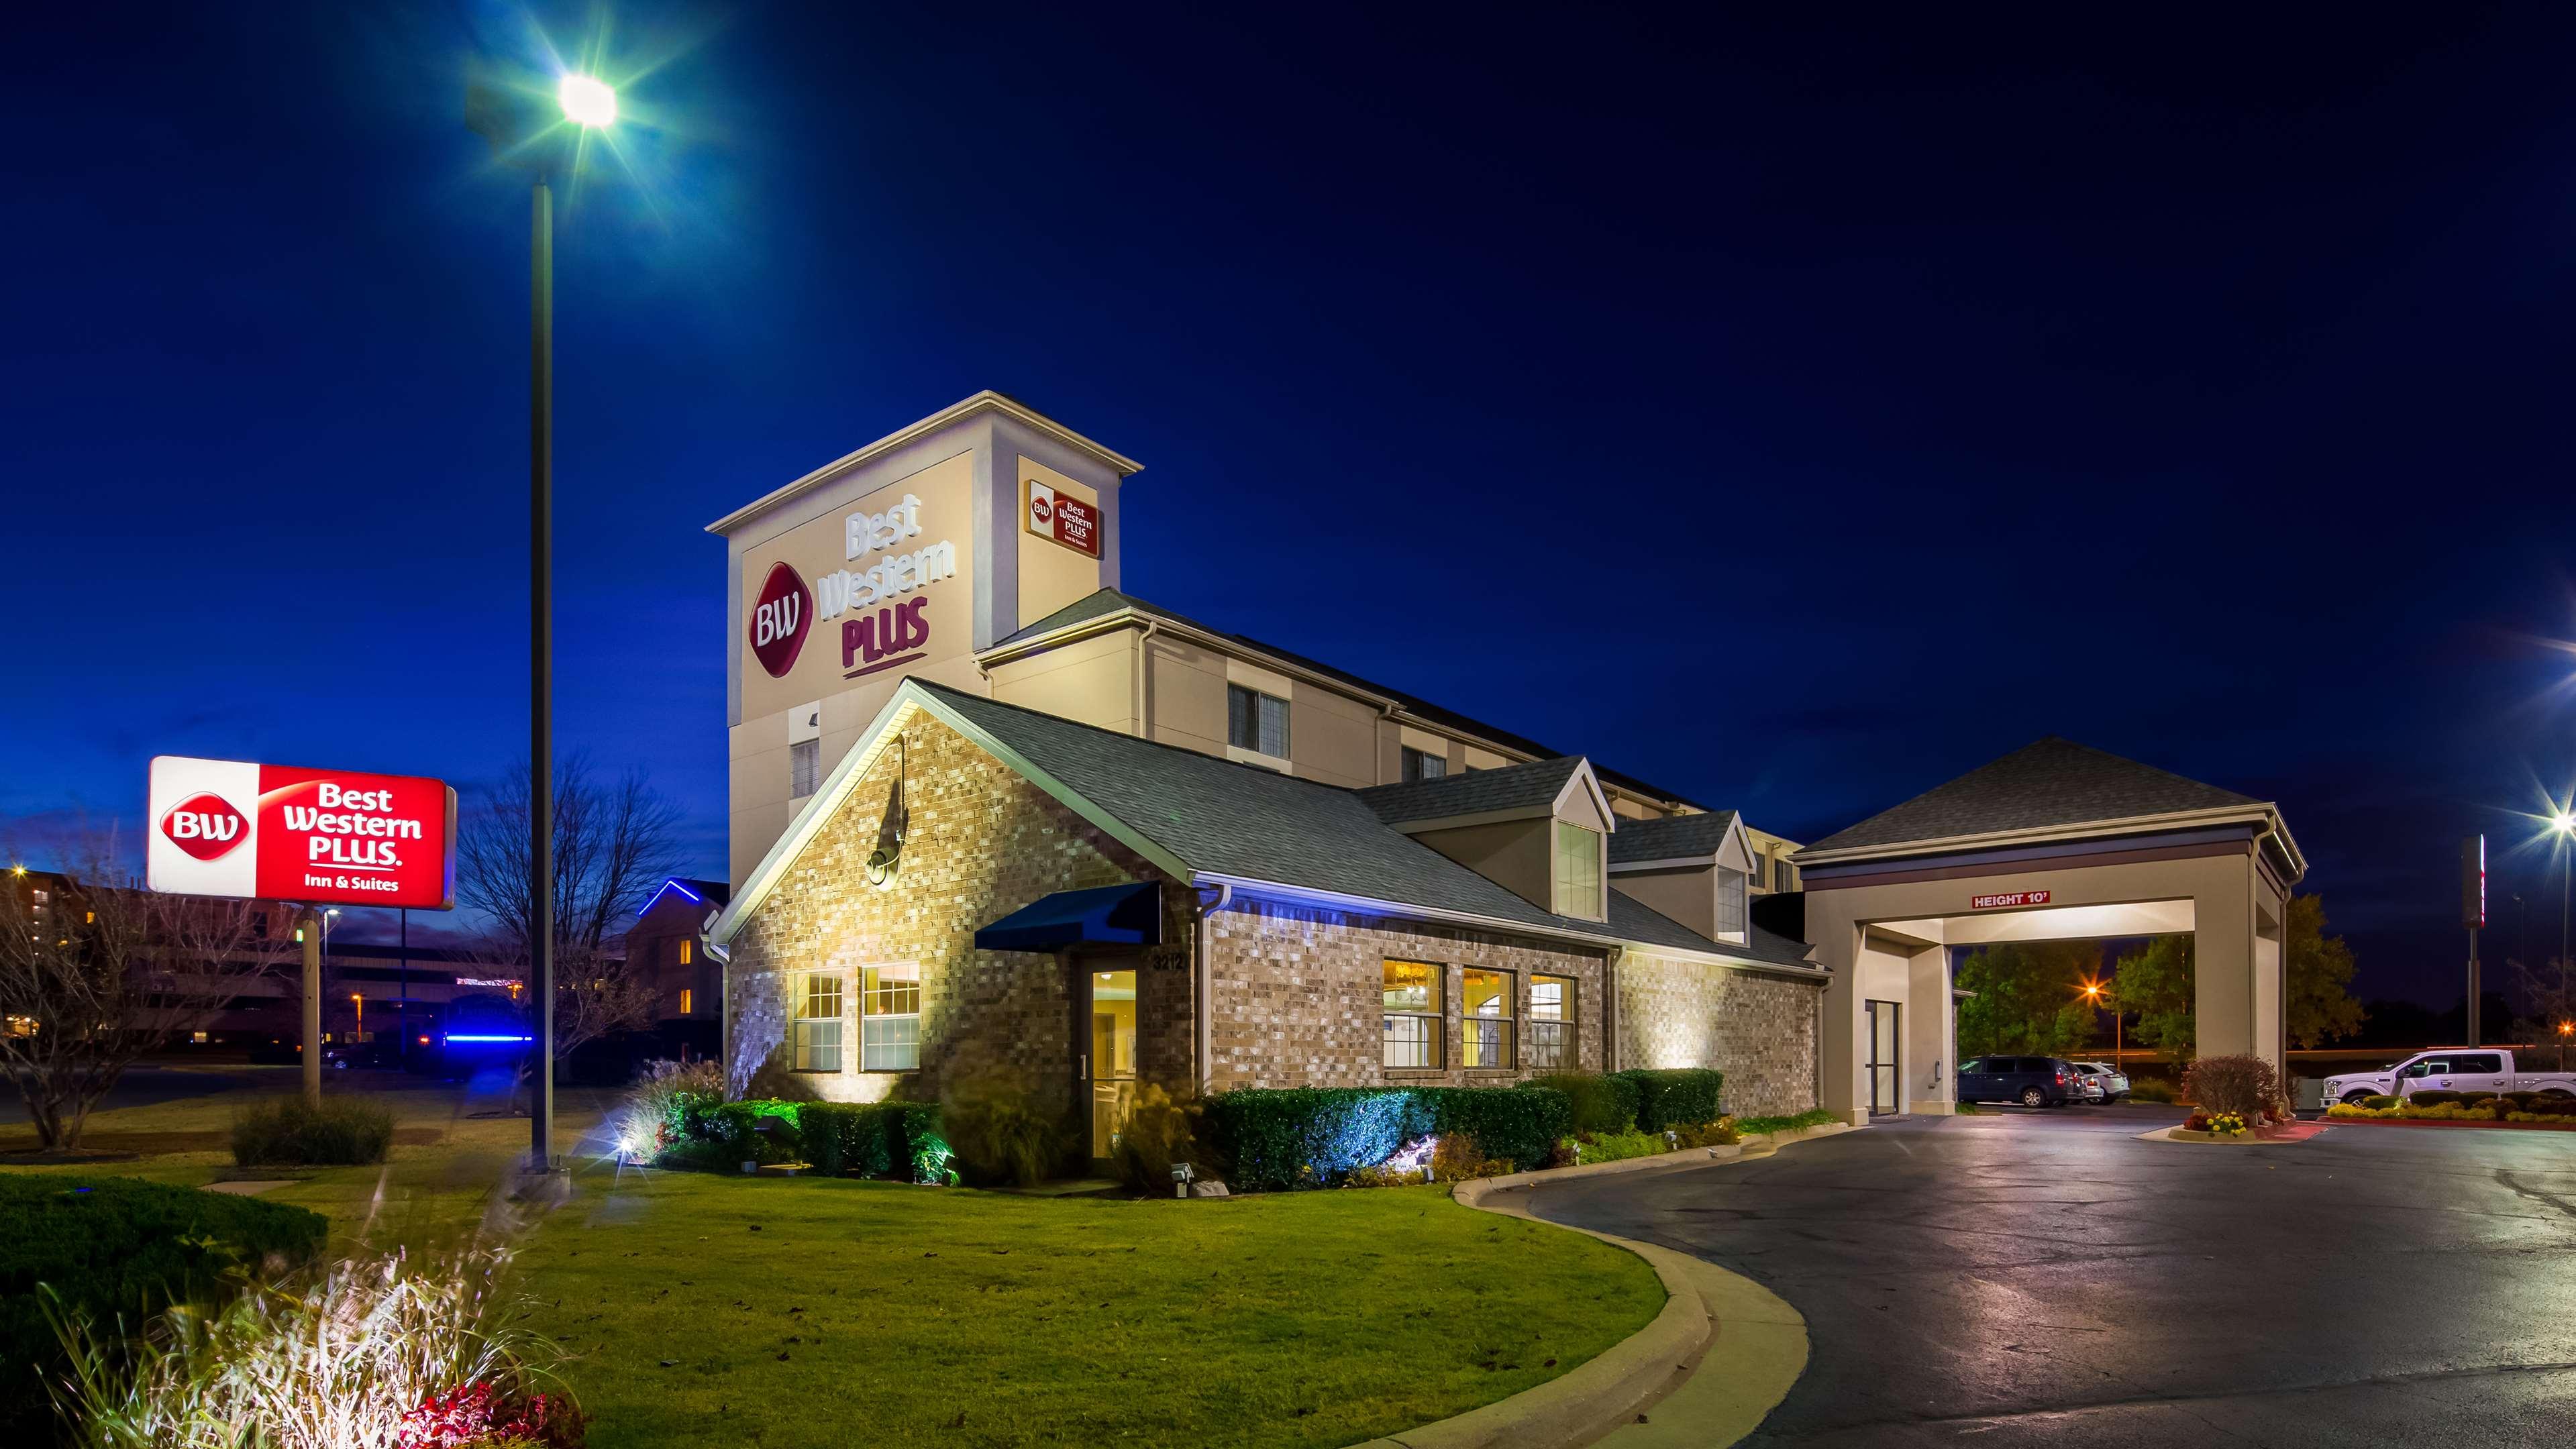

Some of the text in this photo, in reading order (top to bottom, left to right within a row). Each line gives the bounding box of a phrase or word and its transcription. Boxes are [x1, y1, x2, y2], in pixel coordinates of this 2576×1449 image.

[1033, 502, 1049, 517] BW
[1059, 508, 1092, 530] Western
[1067, 502, 1085, 517] Best
[846, 494, 923, 561] Best
[1065, 521, 1086, 537] PLUS
[817, 540, 958, 622] Western
[757, 591, 800, 647] BW
[842, 596, 929, 669] PLUS
[318, 783, 393, 812] Best
[172, 811, 239, 841] BW
[283, 806, 422, 839] Western
[305, 873, 399, 892] Inn & Suites
[1975, 894, 2024, 908] HEIGHT
